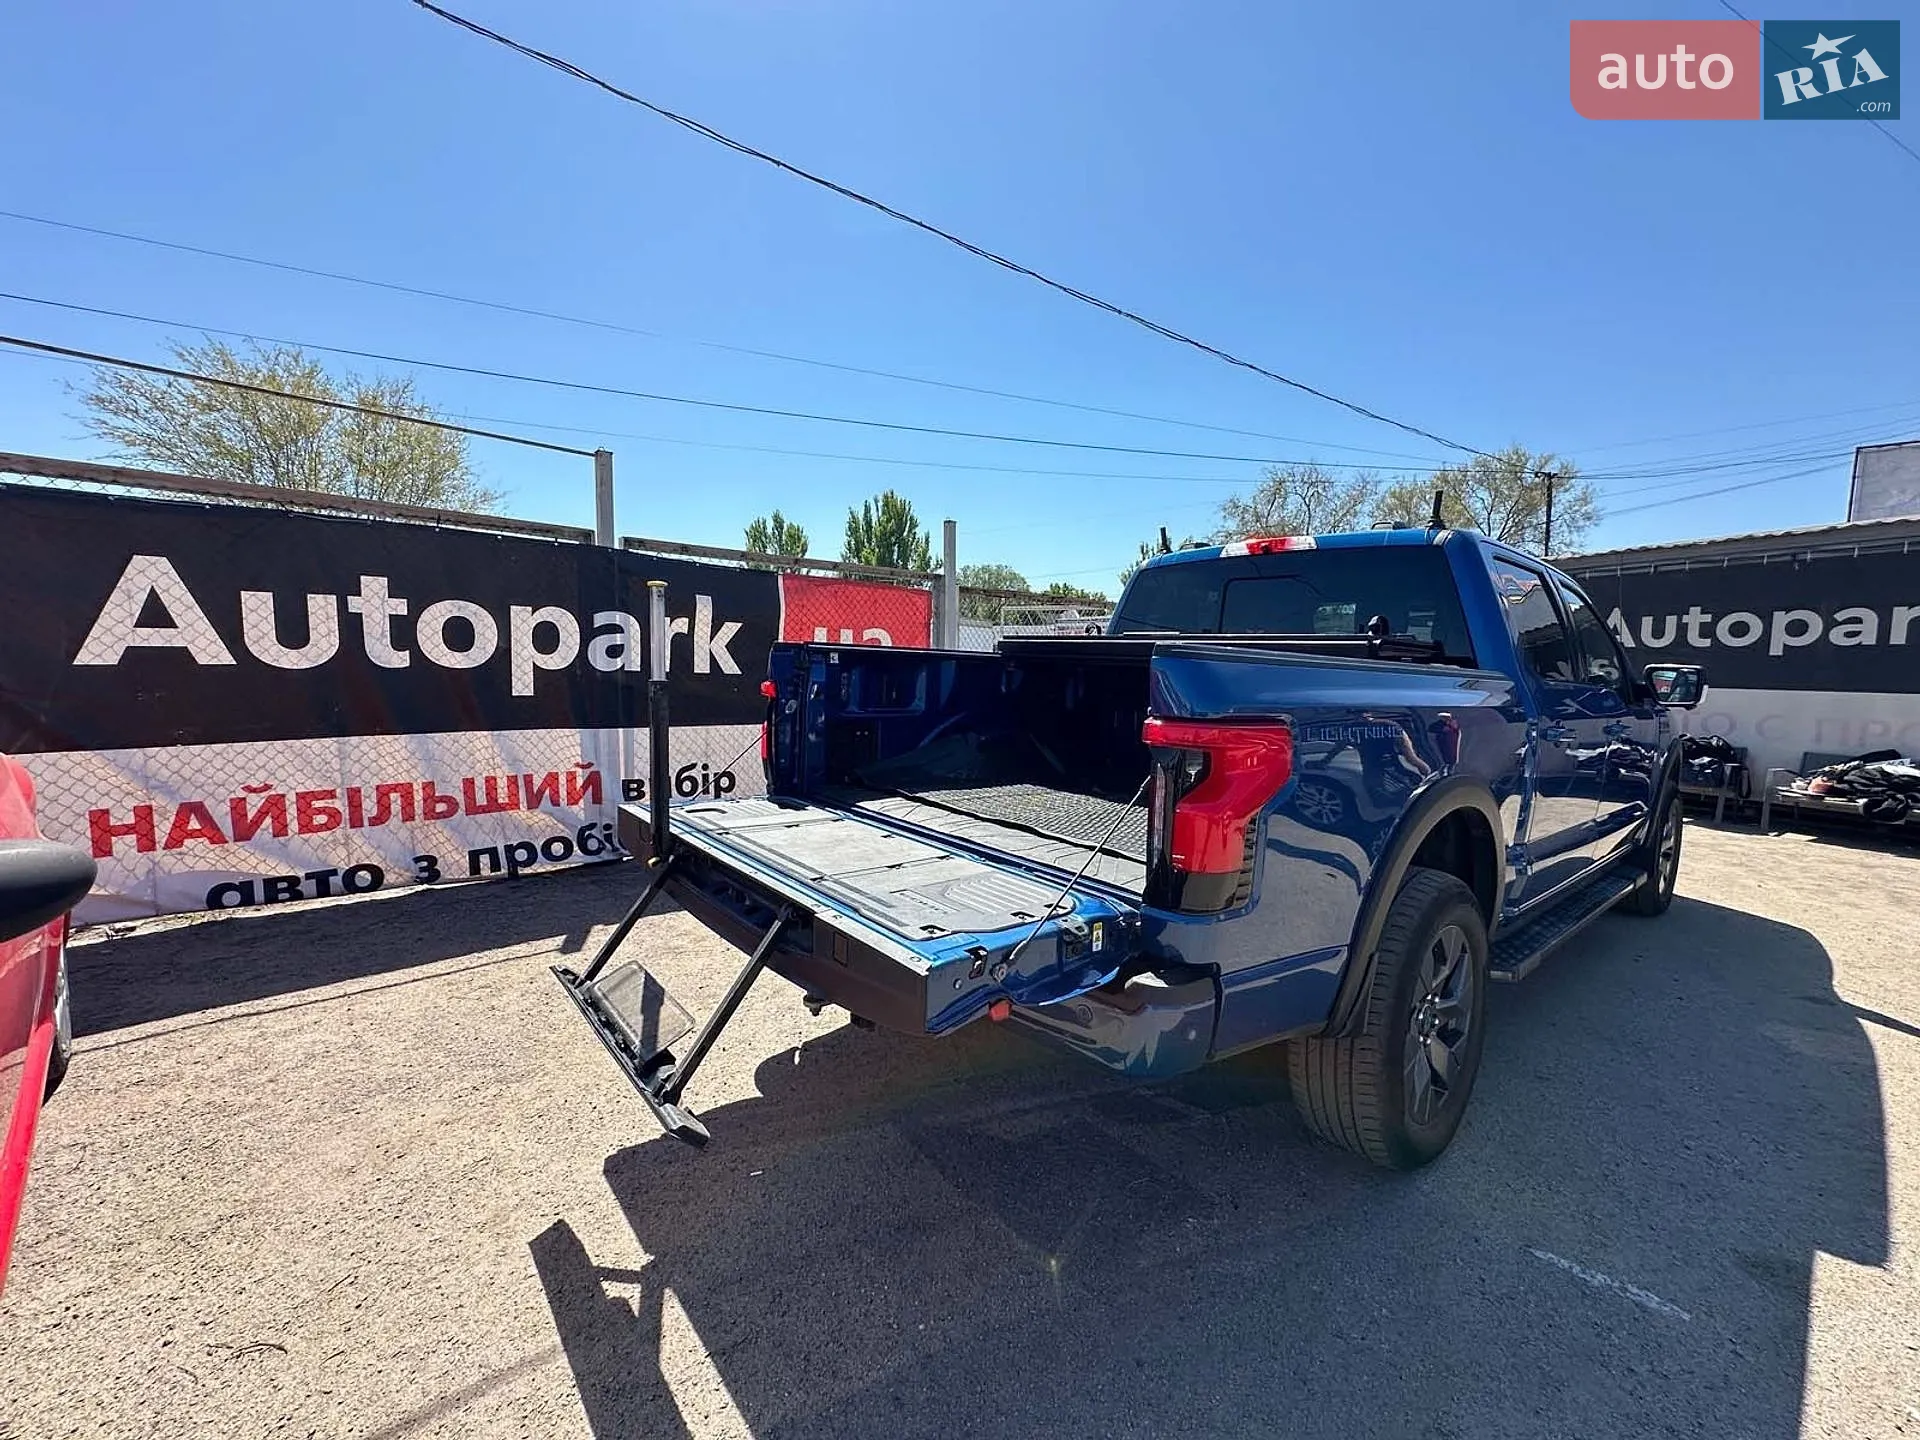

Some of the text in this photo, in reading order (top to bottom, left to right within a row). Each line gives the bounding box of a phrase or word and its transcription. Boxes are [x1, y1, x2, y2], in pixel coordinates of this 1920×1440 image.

[72, 554, 743, 697] Autopark
[88, 762, 736, 858] НАЙБІЛЬШИЙ вбір
[205, 822, 626, 910] авто з пробі
